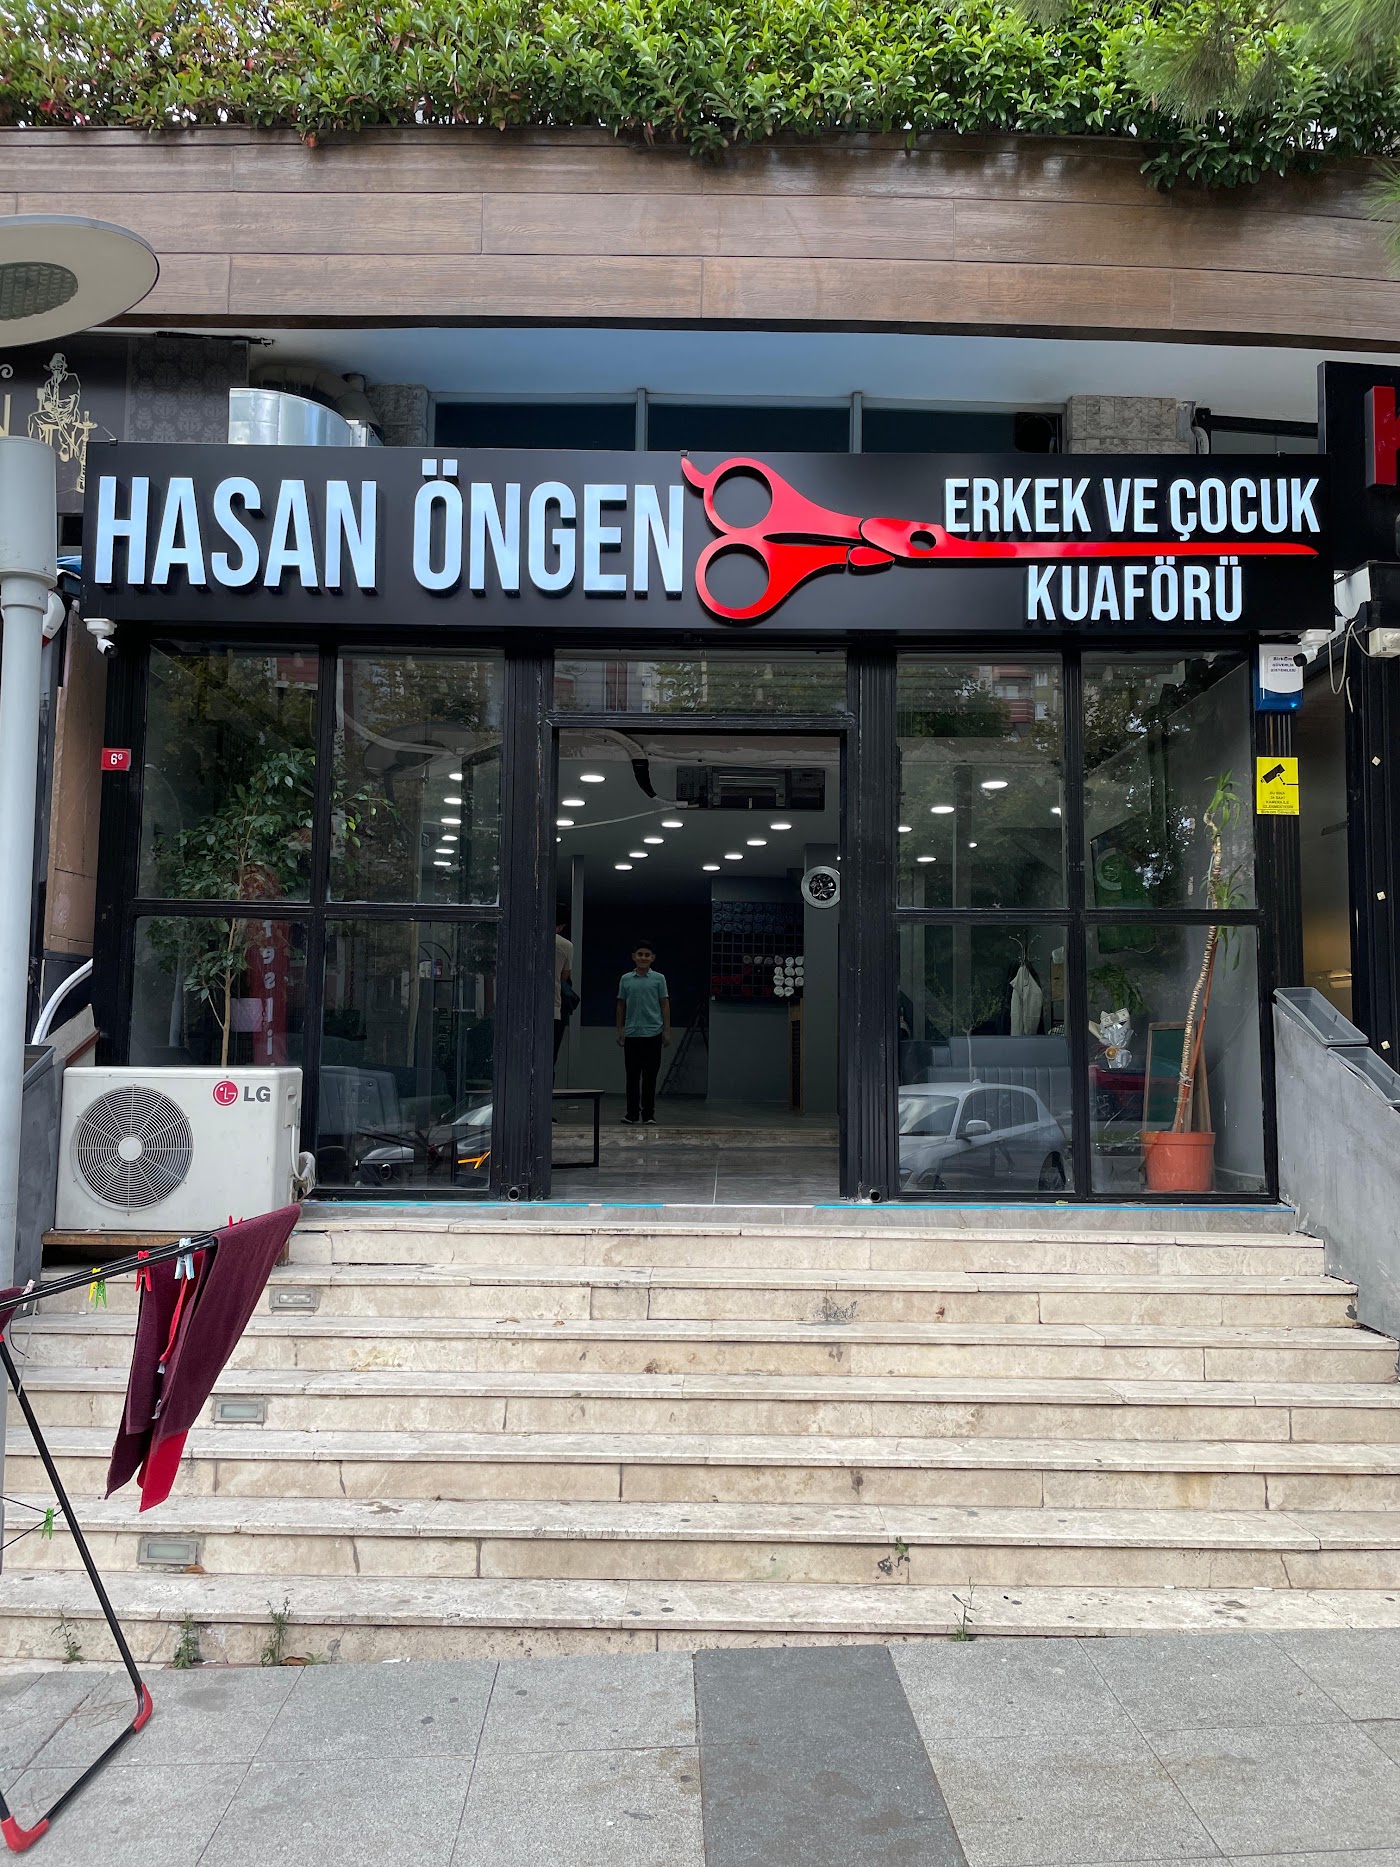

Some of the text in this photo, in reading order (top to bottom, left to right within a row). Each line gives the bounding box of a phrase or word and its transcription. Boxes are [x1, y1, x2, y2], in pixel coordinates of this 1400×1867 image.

[95, 458, 684, 592] HASAN ÖNGEN
[945, 477, 1320, 541] ERKEK VE ÇOCUK
[1027, 556, 1242, 622] KUAFÖRÜ
[243, 1086, 271, 1102] LG
